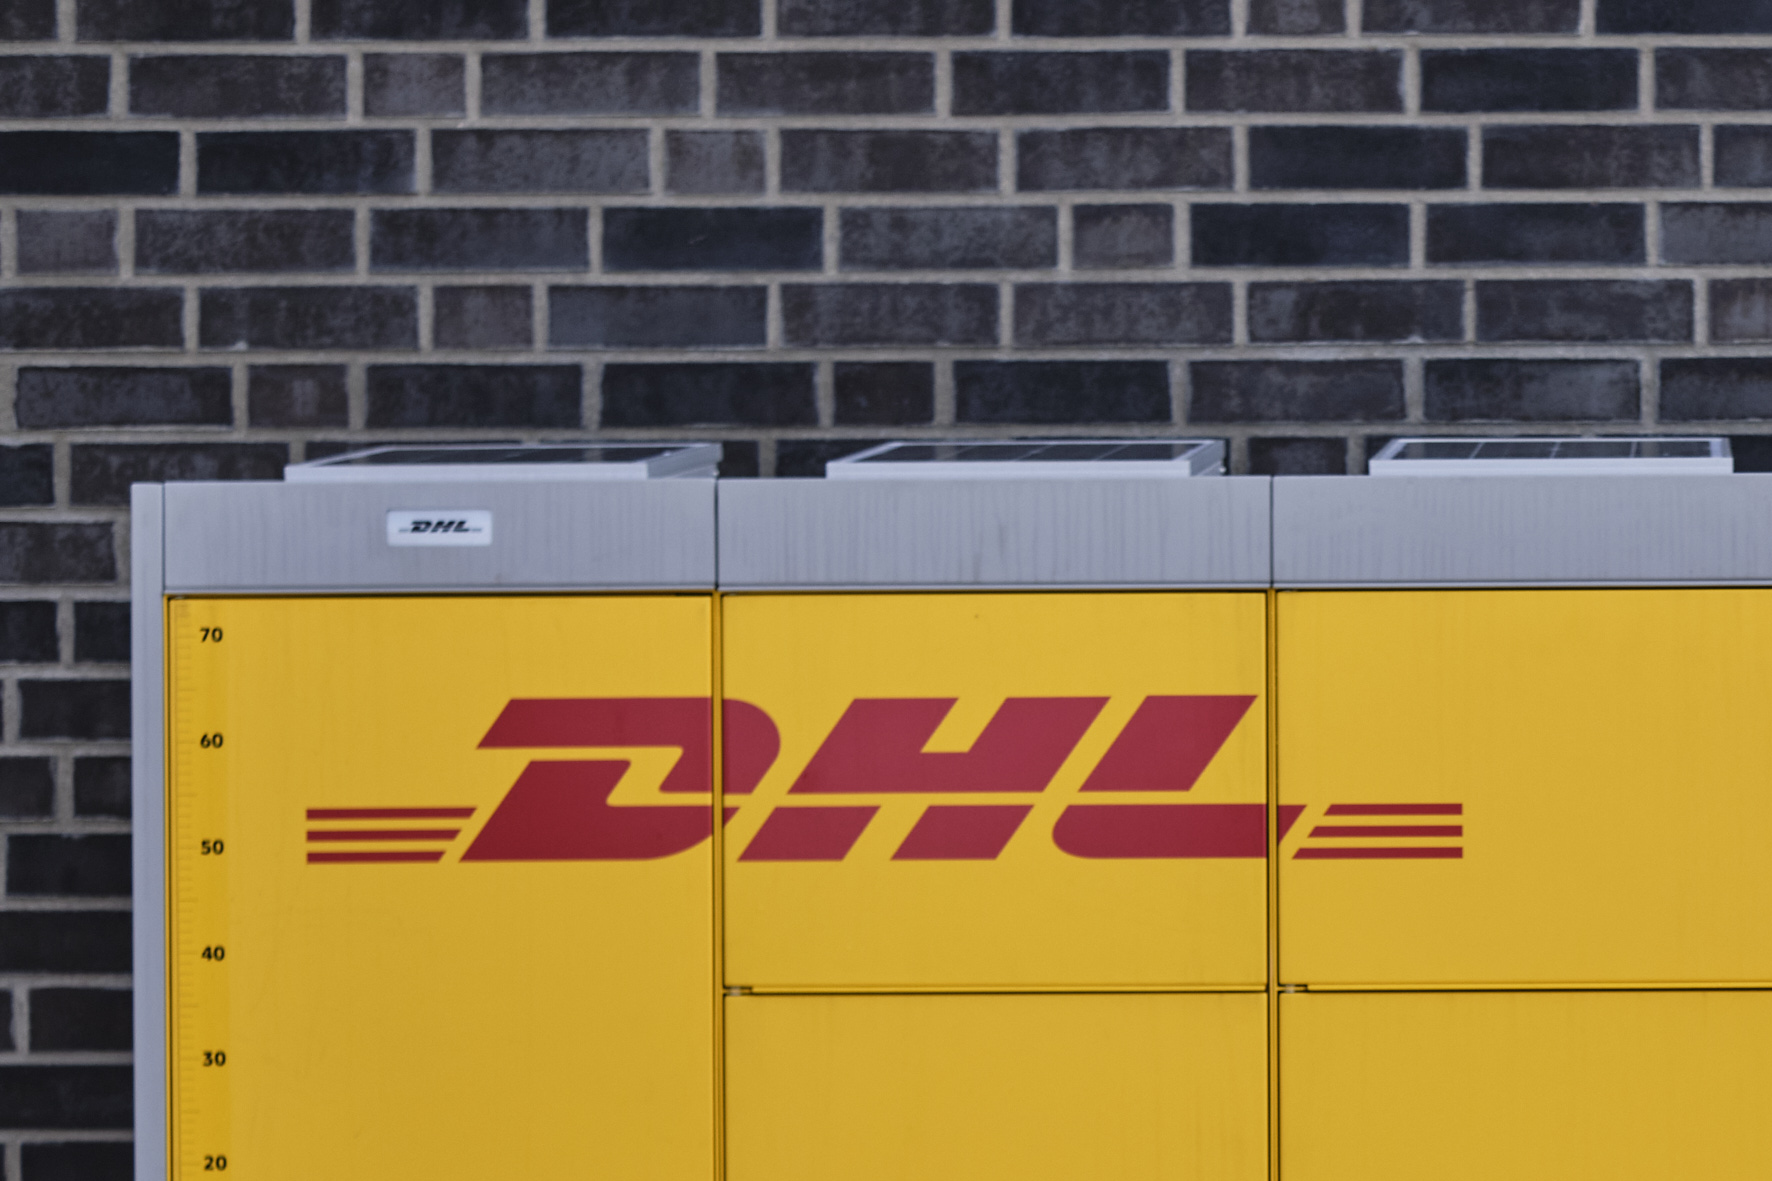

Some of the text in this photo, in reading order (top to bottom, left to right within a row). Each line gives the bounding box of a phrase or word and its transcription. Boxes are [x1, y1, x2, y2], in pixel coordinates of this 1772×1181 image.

[411, 520, 470, 533] DHL
[200, 627, 224, 643] 70
[200, 733, 224, 749] 60
[458, 695, 1308, 863] DHL
[200, 839, 224, 855] 50
[201, 945, 225, 962] 40
[202, 1051, 226, 1067] 30
[203, 1154, 228, 1171] 20
